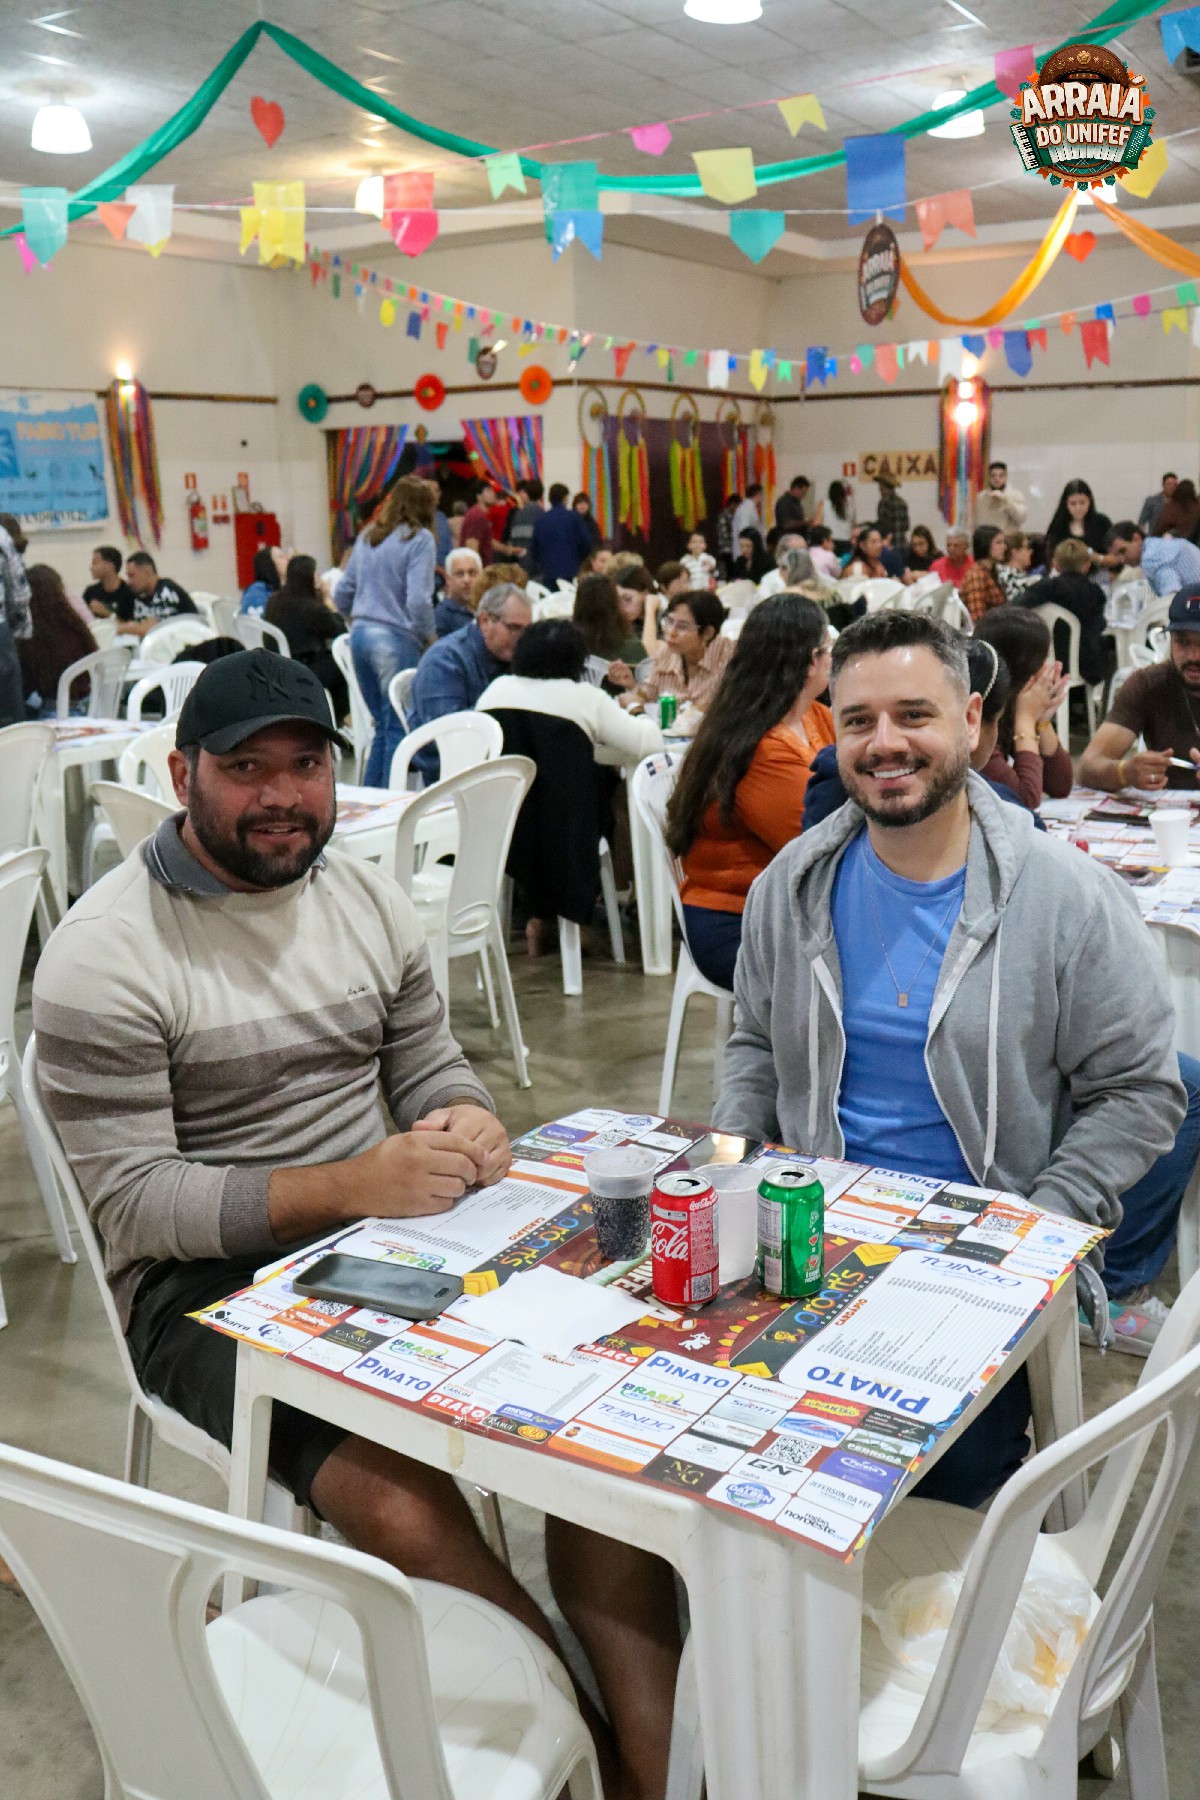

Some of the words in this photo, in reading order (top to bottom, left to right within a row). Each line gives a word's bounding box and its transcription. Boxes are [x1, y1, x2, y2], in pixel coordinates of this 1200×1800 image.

[863, 454, 937, 475] CAIXA
[875, 1169, 943, 1190] PINATO
[920, 1255, 1022, 1288] TOINDO
[835, 1298, 868, 1326] CARDÁPIO
[392, 1339, 444, 1360] BRASIL
[581, 1344, 639, 1363] DEAÇO
[355, 1357, 431, 1391] PINATO
[647, 1355, 730, 1388] PINATO
[621, 1382, 684, 1407] BRASIL
[807, 1366, 930, 1415] PINATO
[598, 1403, 675, 1431] TOINDO
